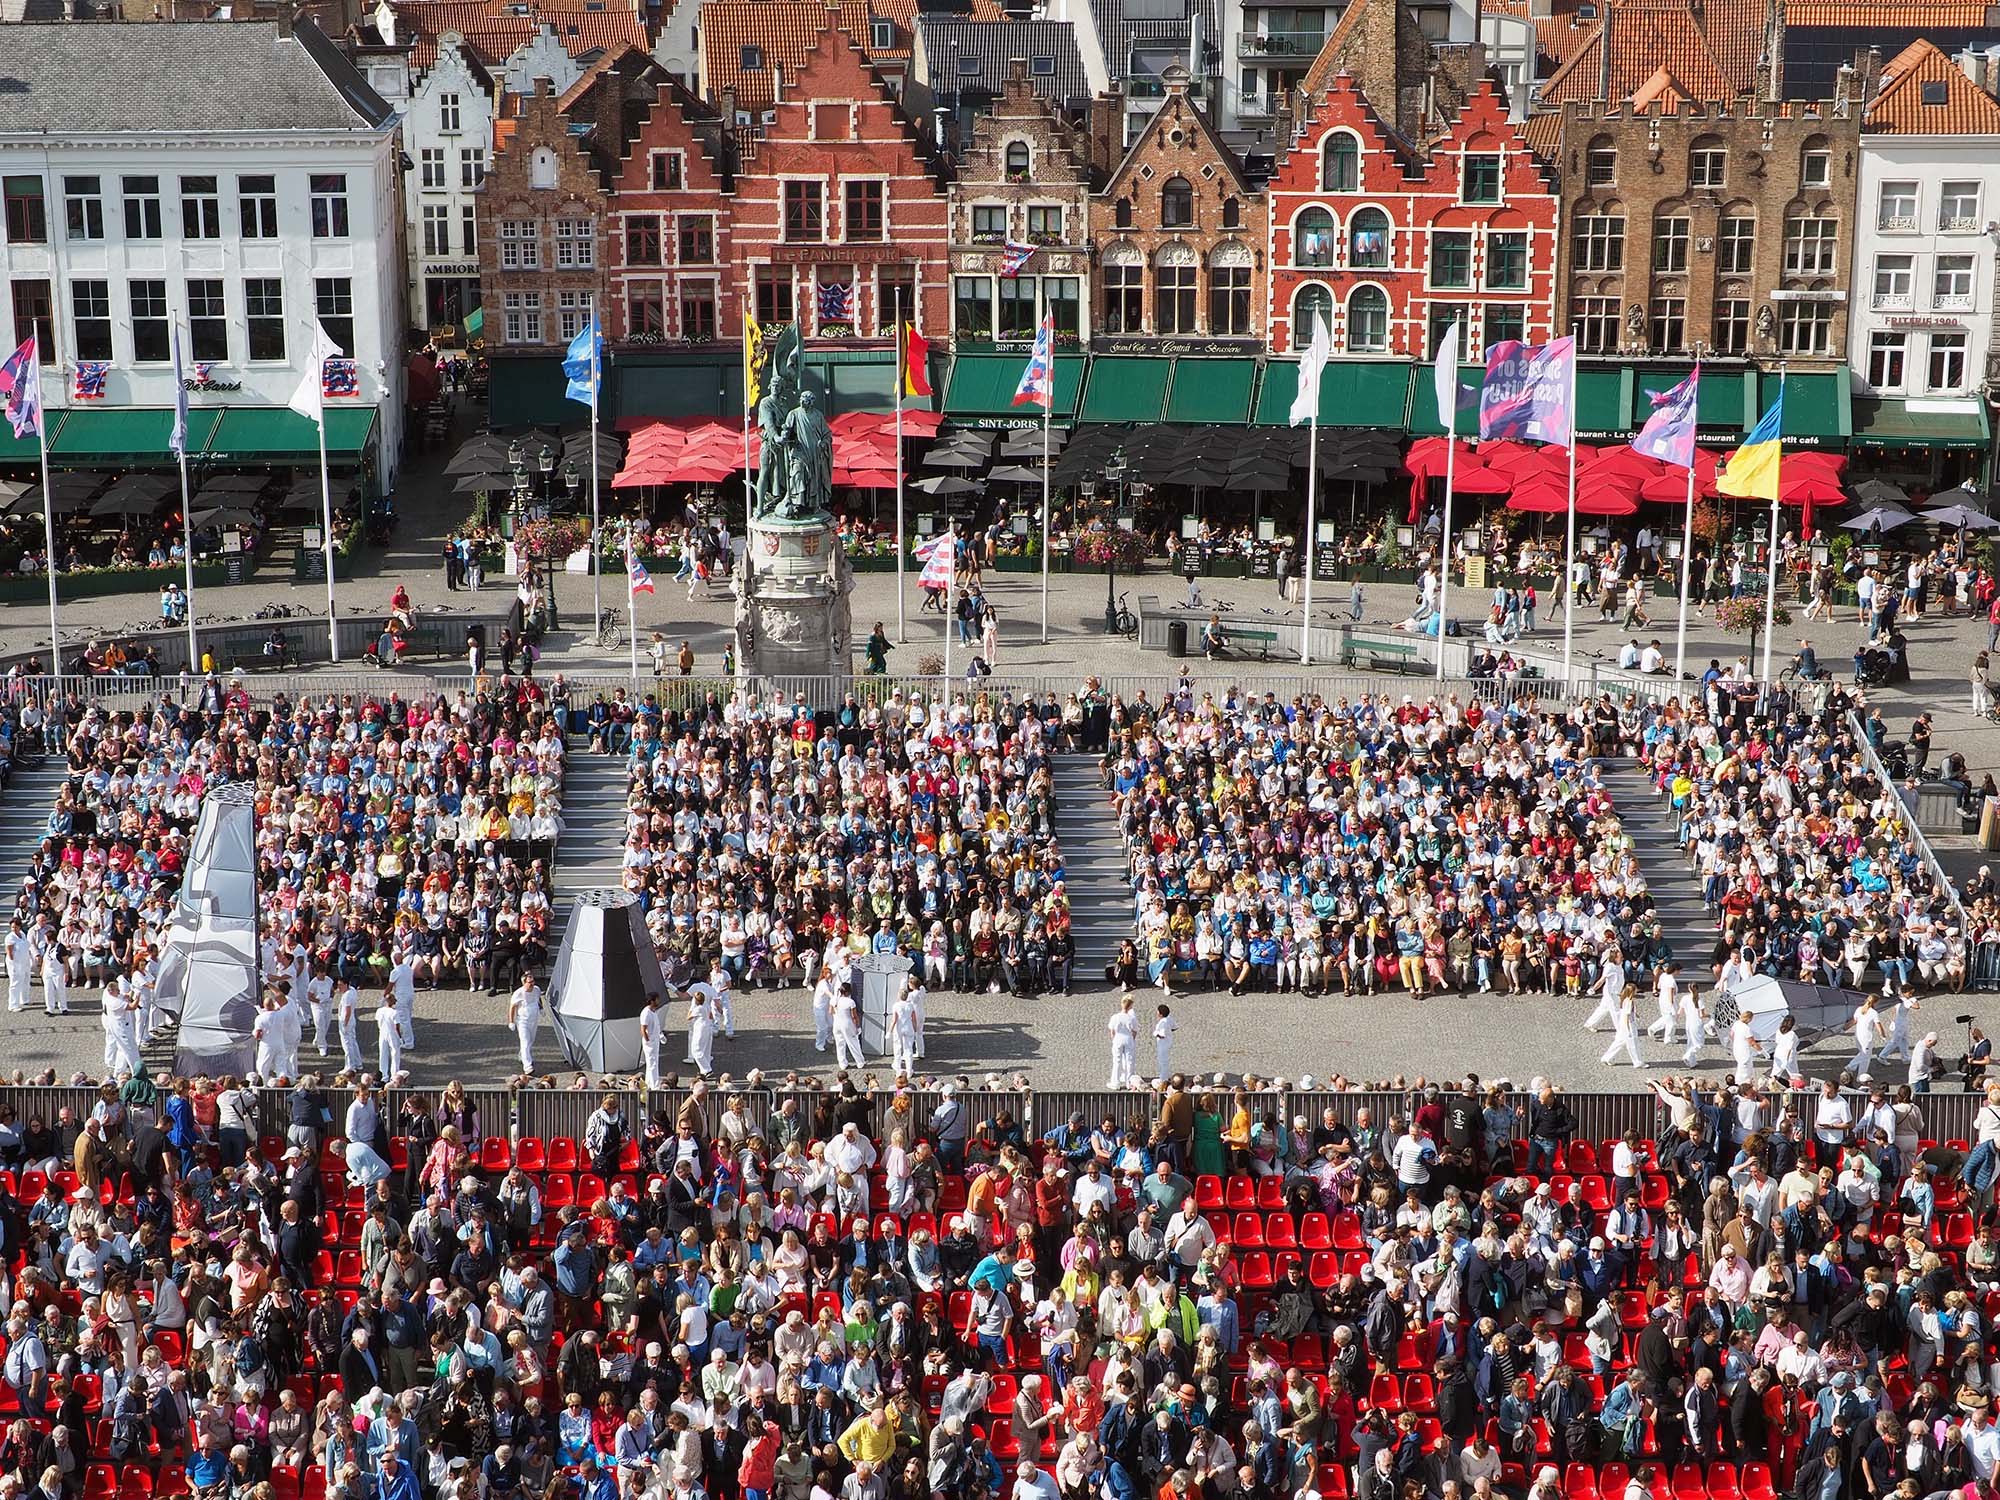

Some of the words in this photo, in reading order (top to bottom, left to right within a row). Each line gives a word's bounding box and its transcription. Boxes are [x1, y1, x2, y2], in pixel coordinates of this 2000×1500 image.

[799, 248, 856, 261] PANIER
[862, 248, 897, 261] D'OR
[1884, 316, 1931, 328] FRITERIE
[1934, 317, 1958, 327] 1900
[995, 343, 1014, 352] SINT
[202, 380, 242, 392] Carré
[978, 418, 1039, 429] SINT-JORIS
[1614, 432, 1625, 440] La
[1799, 436, 1820, 445] café
